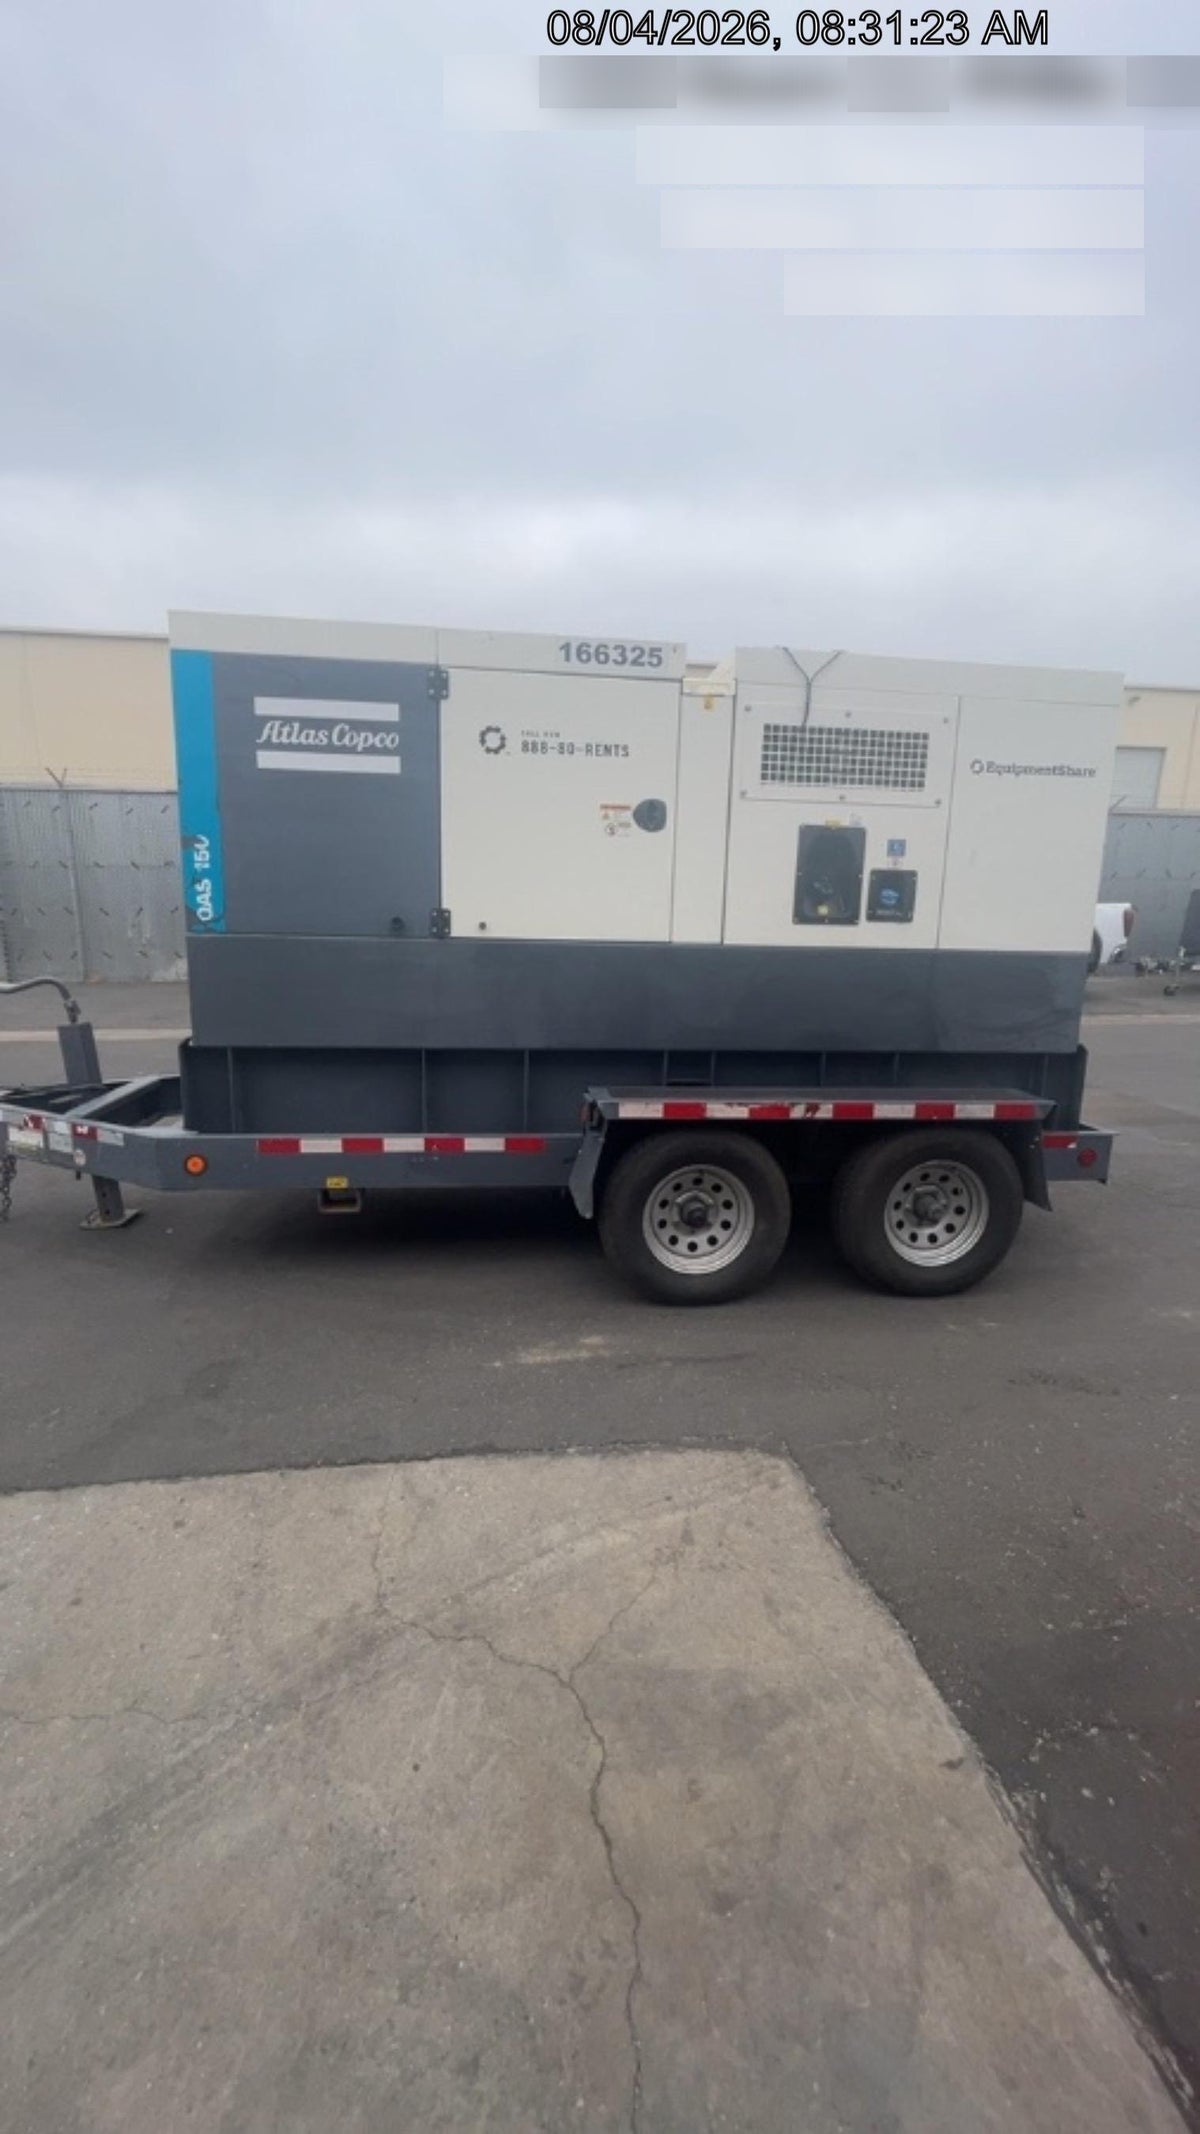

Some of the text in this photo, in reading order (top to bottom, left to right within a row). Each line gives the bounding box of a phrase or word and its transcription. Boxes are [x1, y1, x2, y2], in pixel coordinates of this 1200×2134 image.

[559, 641, 662, 668] 166325
[256, 720, 399, 752] Atlas Copco
[986, 761, 1096, 777] EquipmentShare
